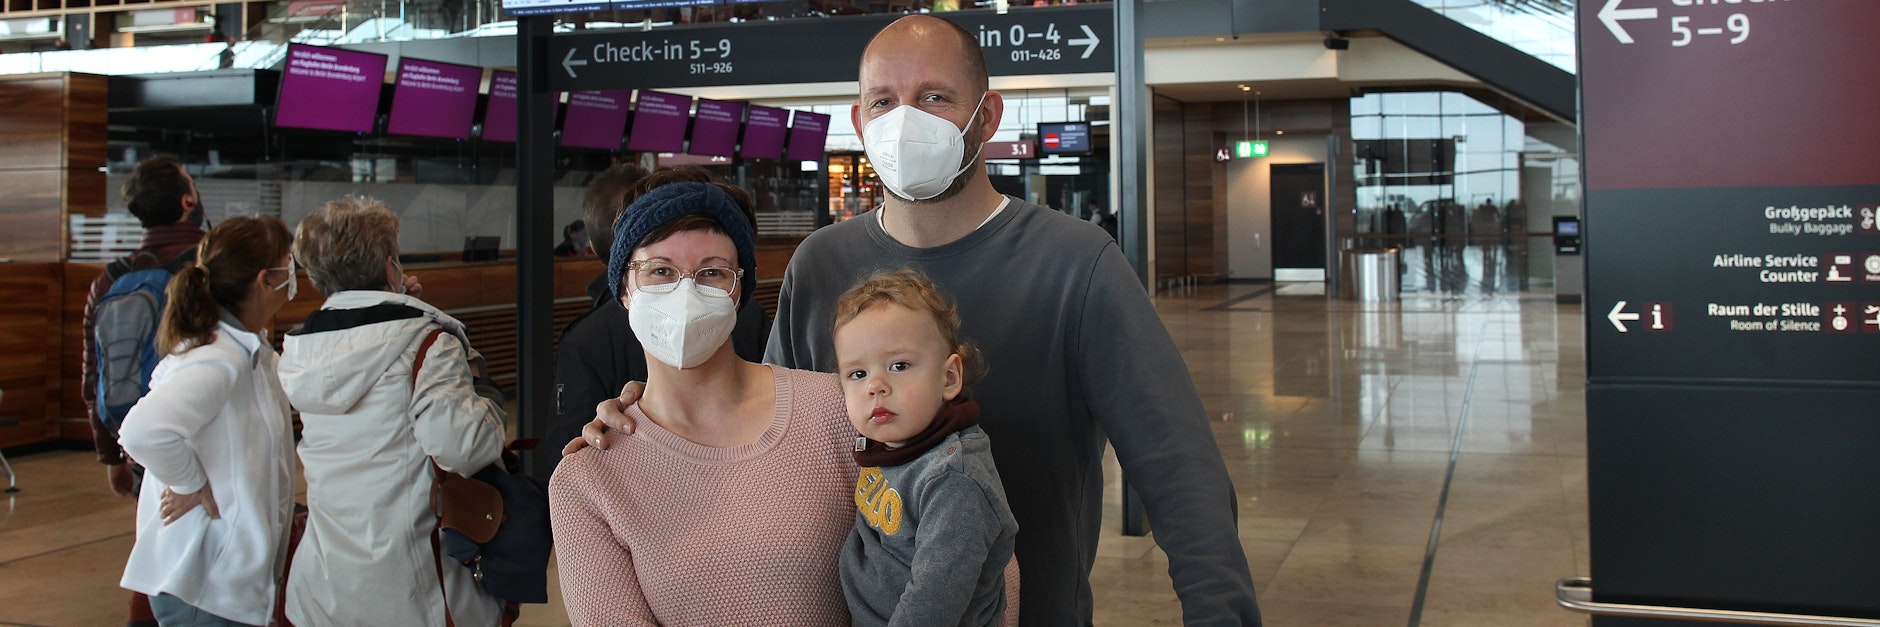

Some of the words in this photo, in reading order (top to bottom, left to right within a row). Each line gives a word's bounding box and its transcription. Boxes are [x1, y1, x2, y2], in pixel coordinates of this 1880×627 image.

[1009, 23, 1061, 46] 0–4
[1671, 13, 1750, 47] 5–9
[593, 40, 683, 63] Check-in
[690, 38, 731, 60] 5–9
[1011, 49, 1061, 62] 011–426
[690, 62, 733, 74] 511–926
[1011, 143, 1027, 156] 3.1
[1764, 204, 1853, 222] Großgepäck
[1769, 222, 1802, 236] Bulky
[1803, 222, 1853, 236] Baggage
[1713, 254, 1762, 268] Airline
[1765, 254, 1818, 268] Service
[1760, 269, 1819, 283] Counter
[1707, 303, 1751, 316] Raum
[1753, 303, 1779, 316] der
[1781, 302, 1820, 317] Stille
[1730, 319, 1764, 331] Room
[1766, 319, 1778, 331] of
[1780, 319, 1821, 332] Silence
[855, 466, 902, 535] ELLO
